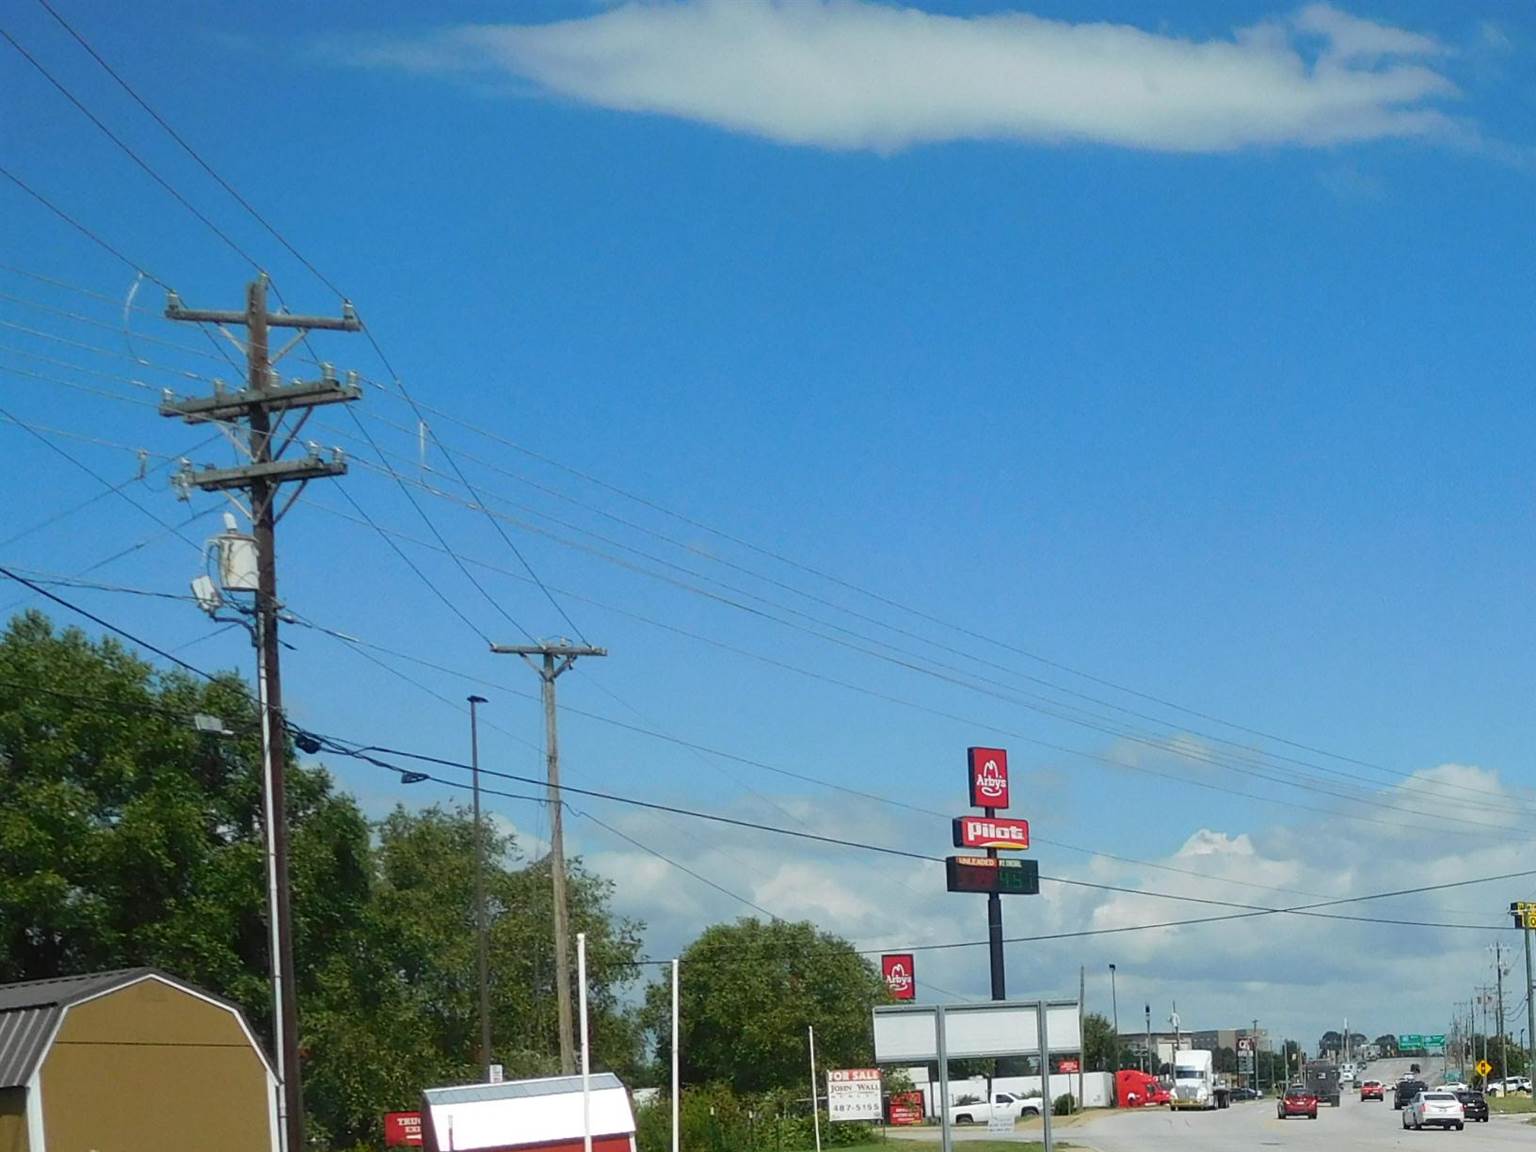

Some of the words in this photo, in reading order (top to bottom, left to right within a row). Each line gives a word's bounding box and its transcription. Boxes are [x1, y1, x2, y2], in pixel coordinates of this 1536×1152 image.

[976, 774, 1007, 790] Arby's
[967, 821, 1024, 841] Pilot
[828, 1072, 848, 1081] FOR
[853, 1070, 879, 1080] SALE
